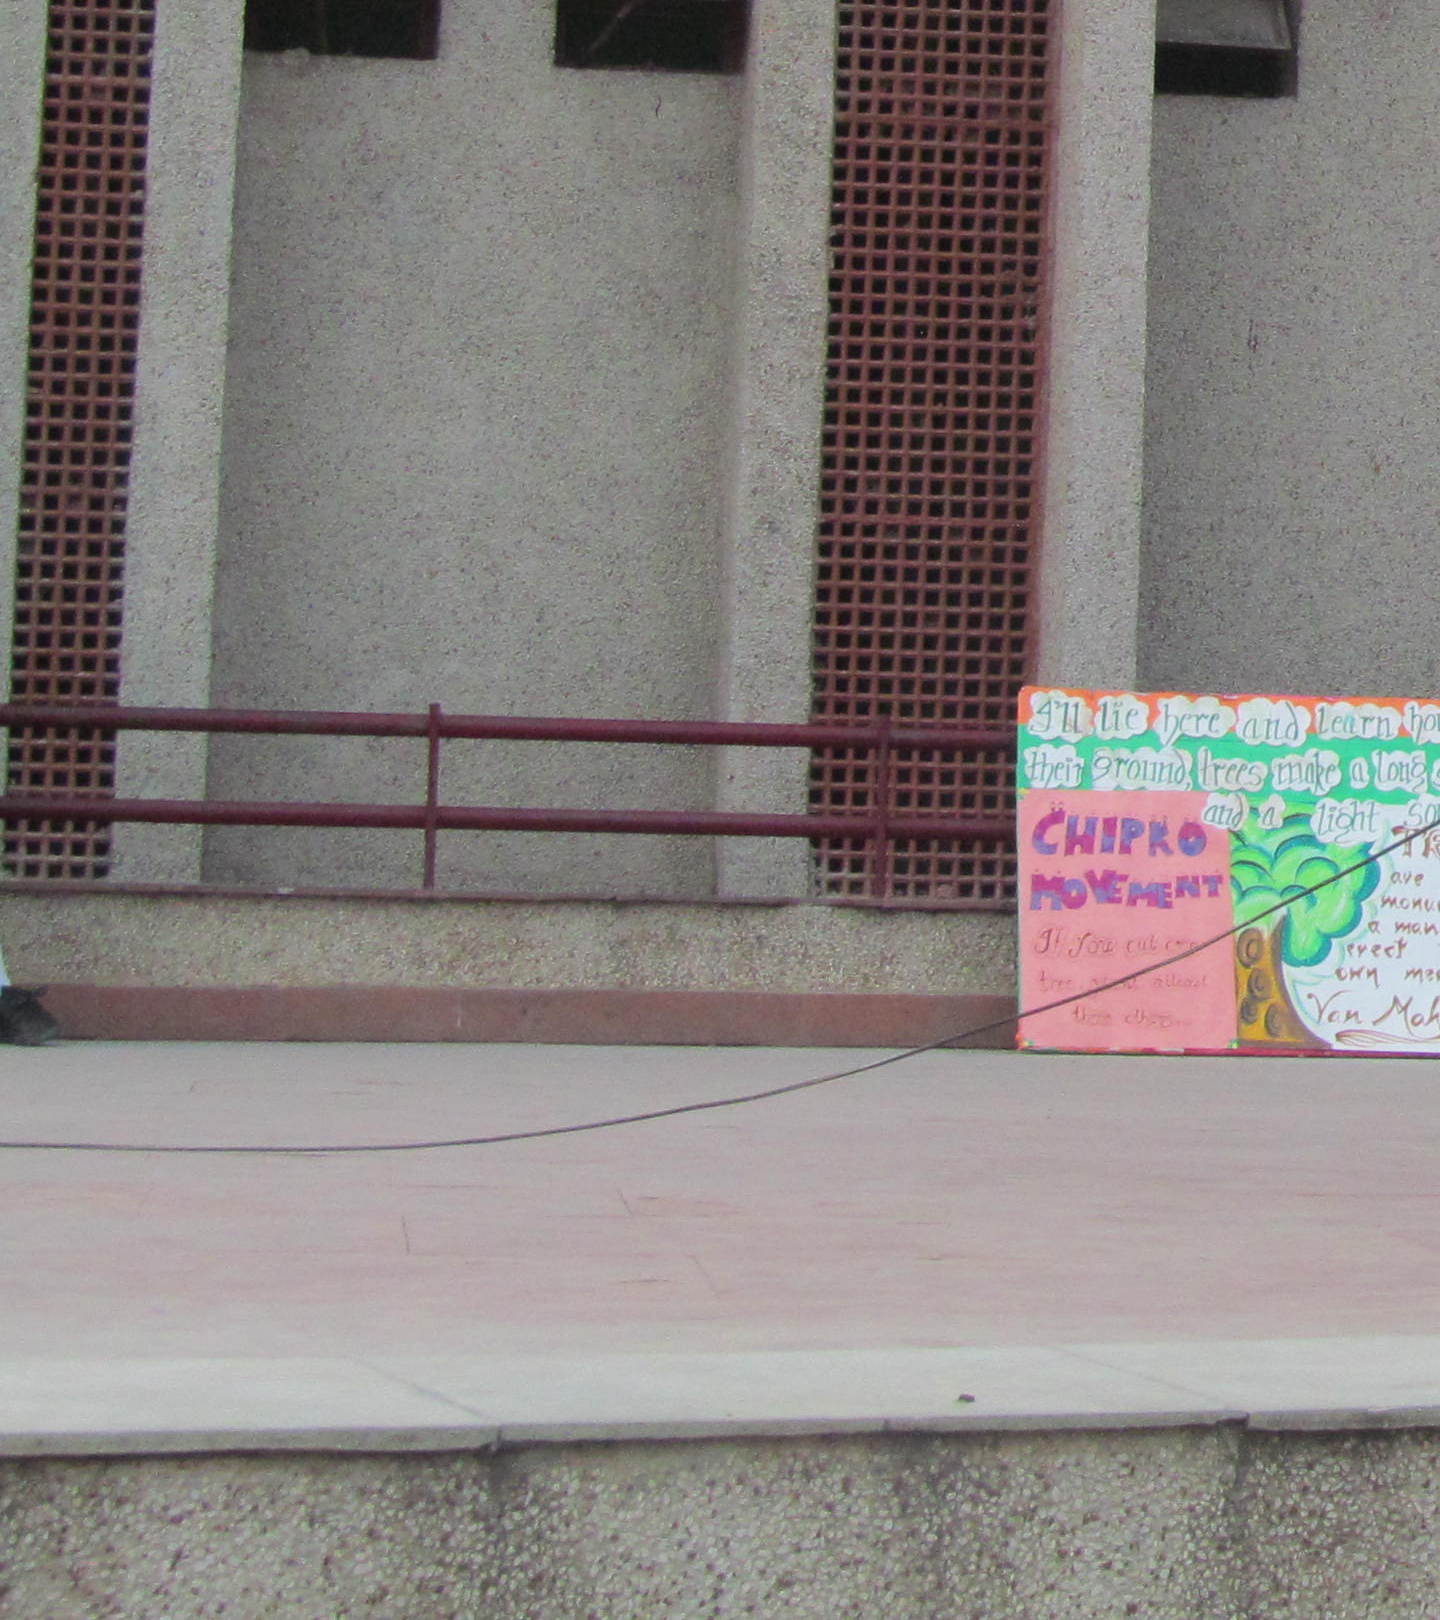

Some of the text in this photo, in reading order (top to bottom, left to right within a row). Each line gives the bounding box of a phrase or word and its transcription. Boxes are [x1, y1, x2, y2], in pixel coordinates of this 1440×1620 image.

[1099, 700, 1139, 733] lie
[1161, 702, 1221, 741] here
[1241, 700, 1299, 741] and
[1316, 705, 1395, 739] learn
[1030, 750, 1083, 788] their
[1093, 748, 1192, 790] ground,
[1200, 749, 1263, 786] trees
[1274, 751, 1339, 793] make
[1350, 761, 1367, 784] a
[1371, 750, 1428, 793] long
[1203, 793, 1245, 829] and
[1261, 805, 1276, 826] a
[1317, 801, 1380, 843] light
[1029, 869, 1224, 911] MOVEMENT
[1366, 920, 1381, 934] a
[1394, 921, 1440, 936] man
[1334, 967, 1381, 989] own
